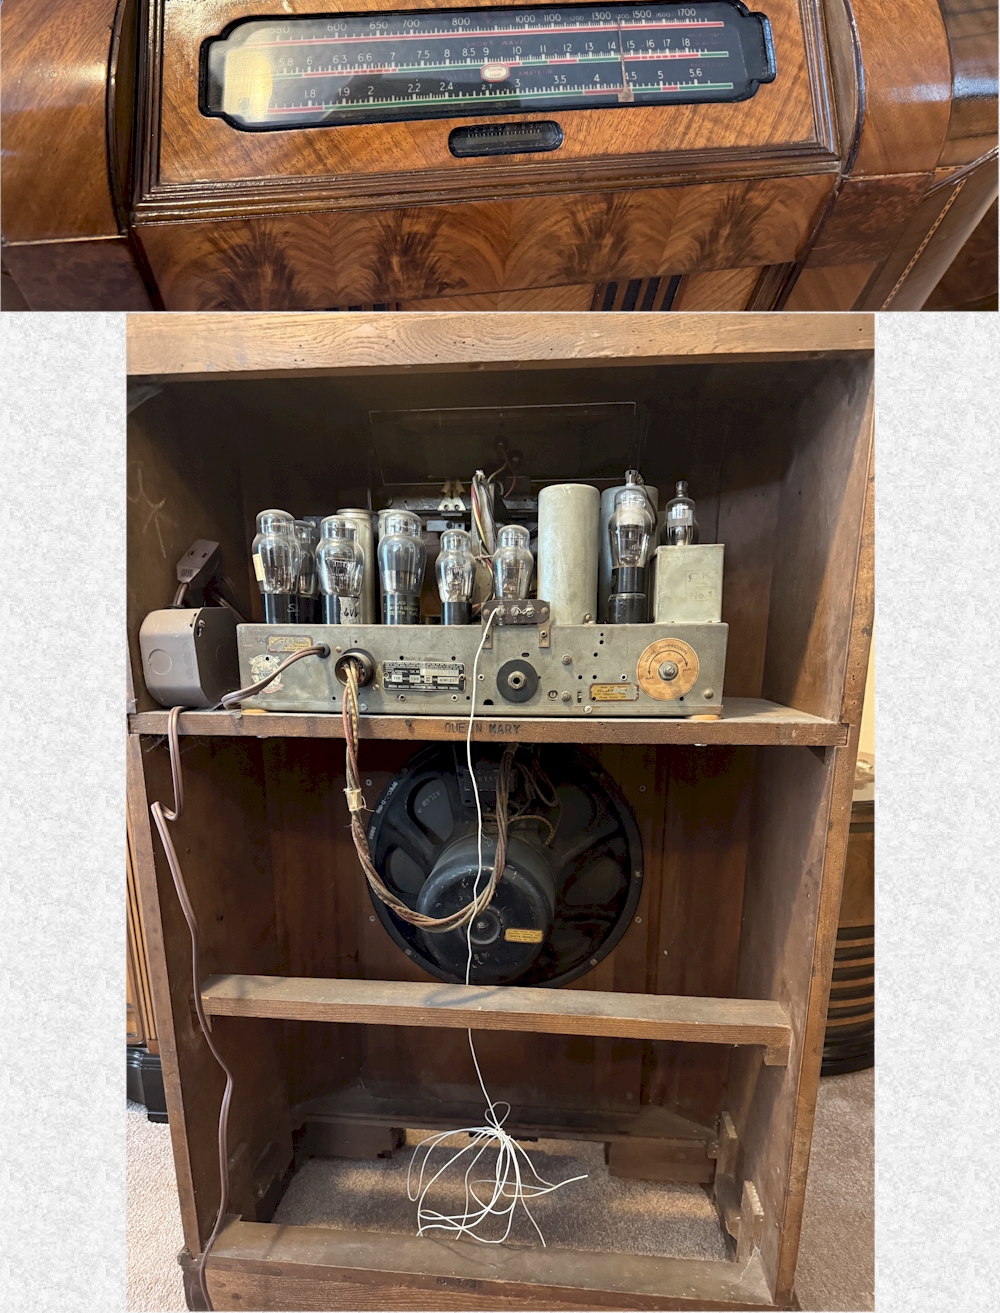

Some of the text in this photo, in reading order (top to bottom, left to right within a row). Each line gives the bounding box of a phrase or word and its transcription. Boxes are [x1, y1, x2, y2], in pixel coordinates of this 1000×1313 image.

[327, 23, 347, 31] 600
[369, 21, 388, 29] 650
[402, 19, 420, 28] 700
[452, 18, 470, 26] 800
[515, 15, 536, 23] 1000
[544, 14, 561, 22] 1100
[592, 12, 611, 20] 1300
[632, 10, 652, 18] 1500
[678, 8, 696, 16] 1700
[306, 56, 313, 65] 6
[332, 55, 347, 64] 6.3
[358, 53, 372, 61] 6.6
[390, 52, 396, 60] 7
[417, 50, 430, 59] 7.5
[444, 49, 450, 57] 8
[462, 48, 476, 56] 8.5
[483, 47, 489, 56] 9
[513, 46, 522, 54] 10
[627, 41, 635, 49] 15
[646, 39, 655, 47] 16
[682, 38, 690, 46] 18
[304, 89, 316, 98] 1.8
[338, 88, 350, 96] 1.9
[368, 86, 374, 95] 2
[408, 84, 421, 92] 2.2
[440, 82, 454, 91] 2.4
[515, 79, 520, 87] 3
[554, 75, 567, 84] 3.5
[594, 74, 600, 82] 4
[658, 71, 664, 79] 5
[689, 68, 702, 77] 5.6
[445, 722, 520, 734] QUEN MARY
